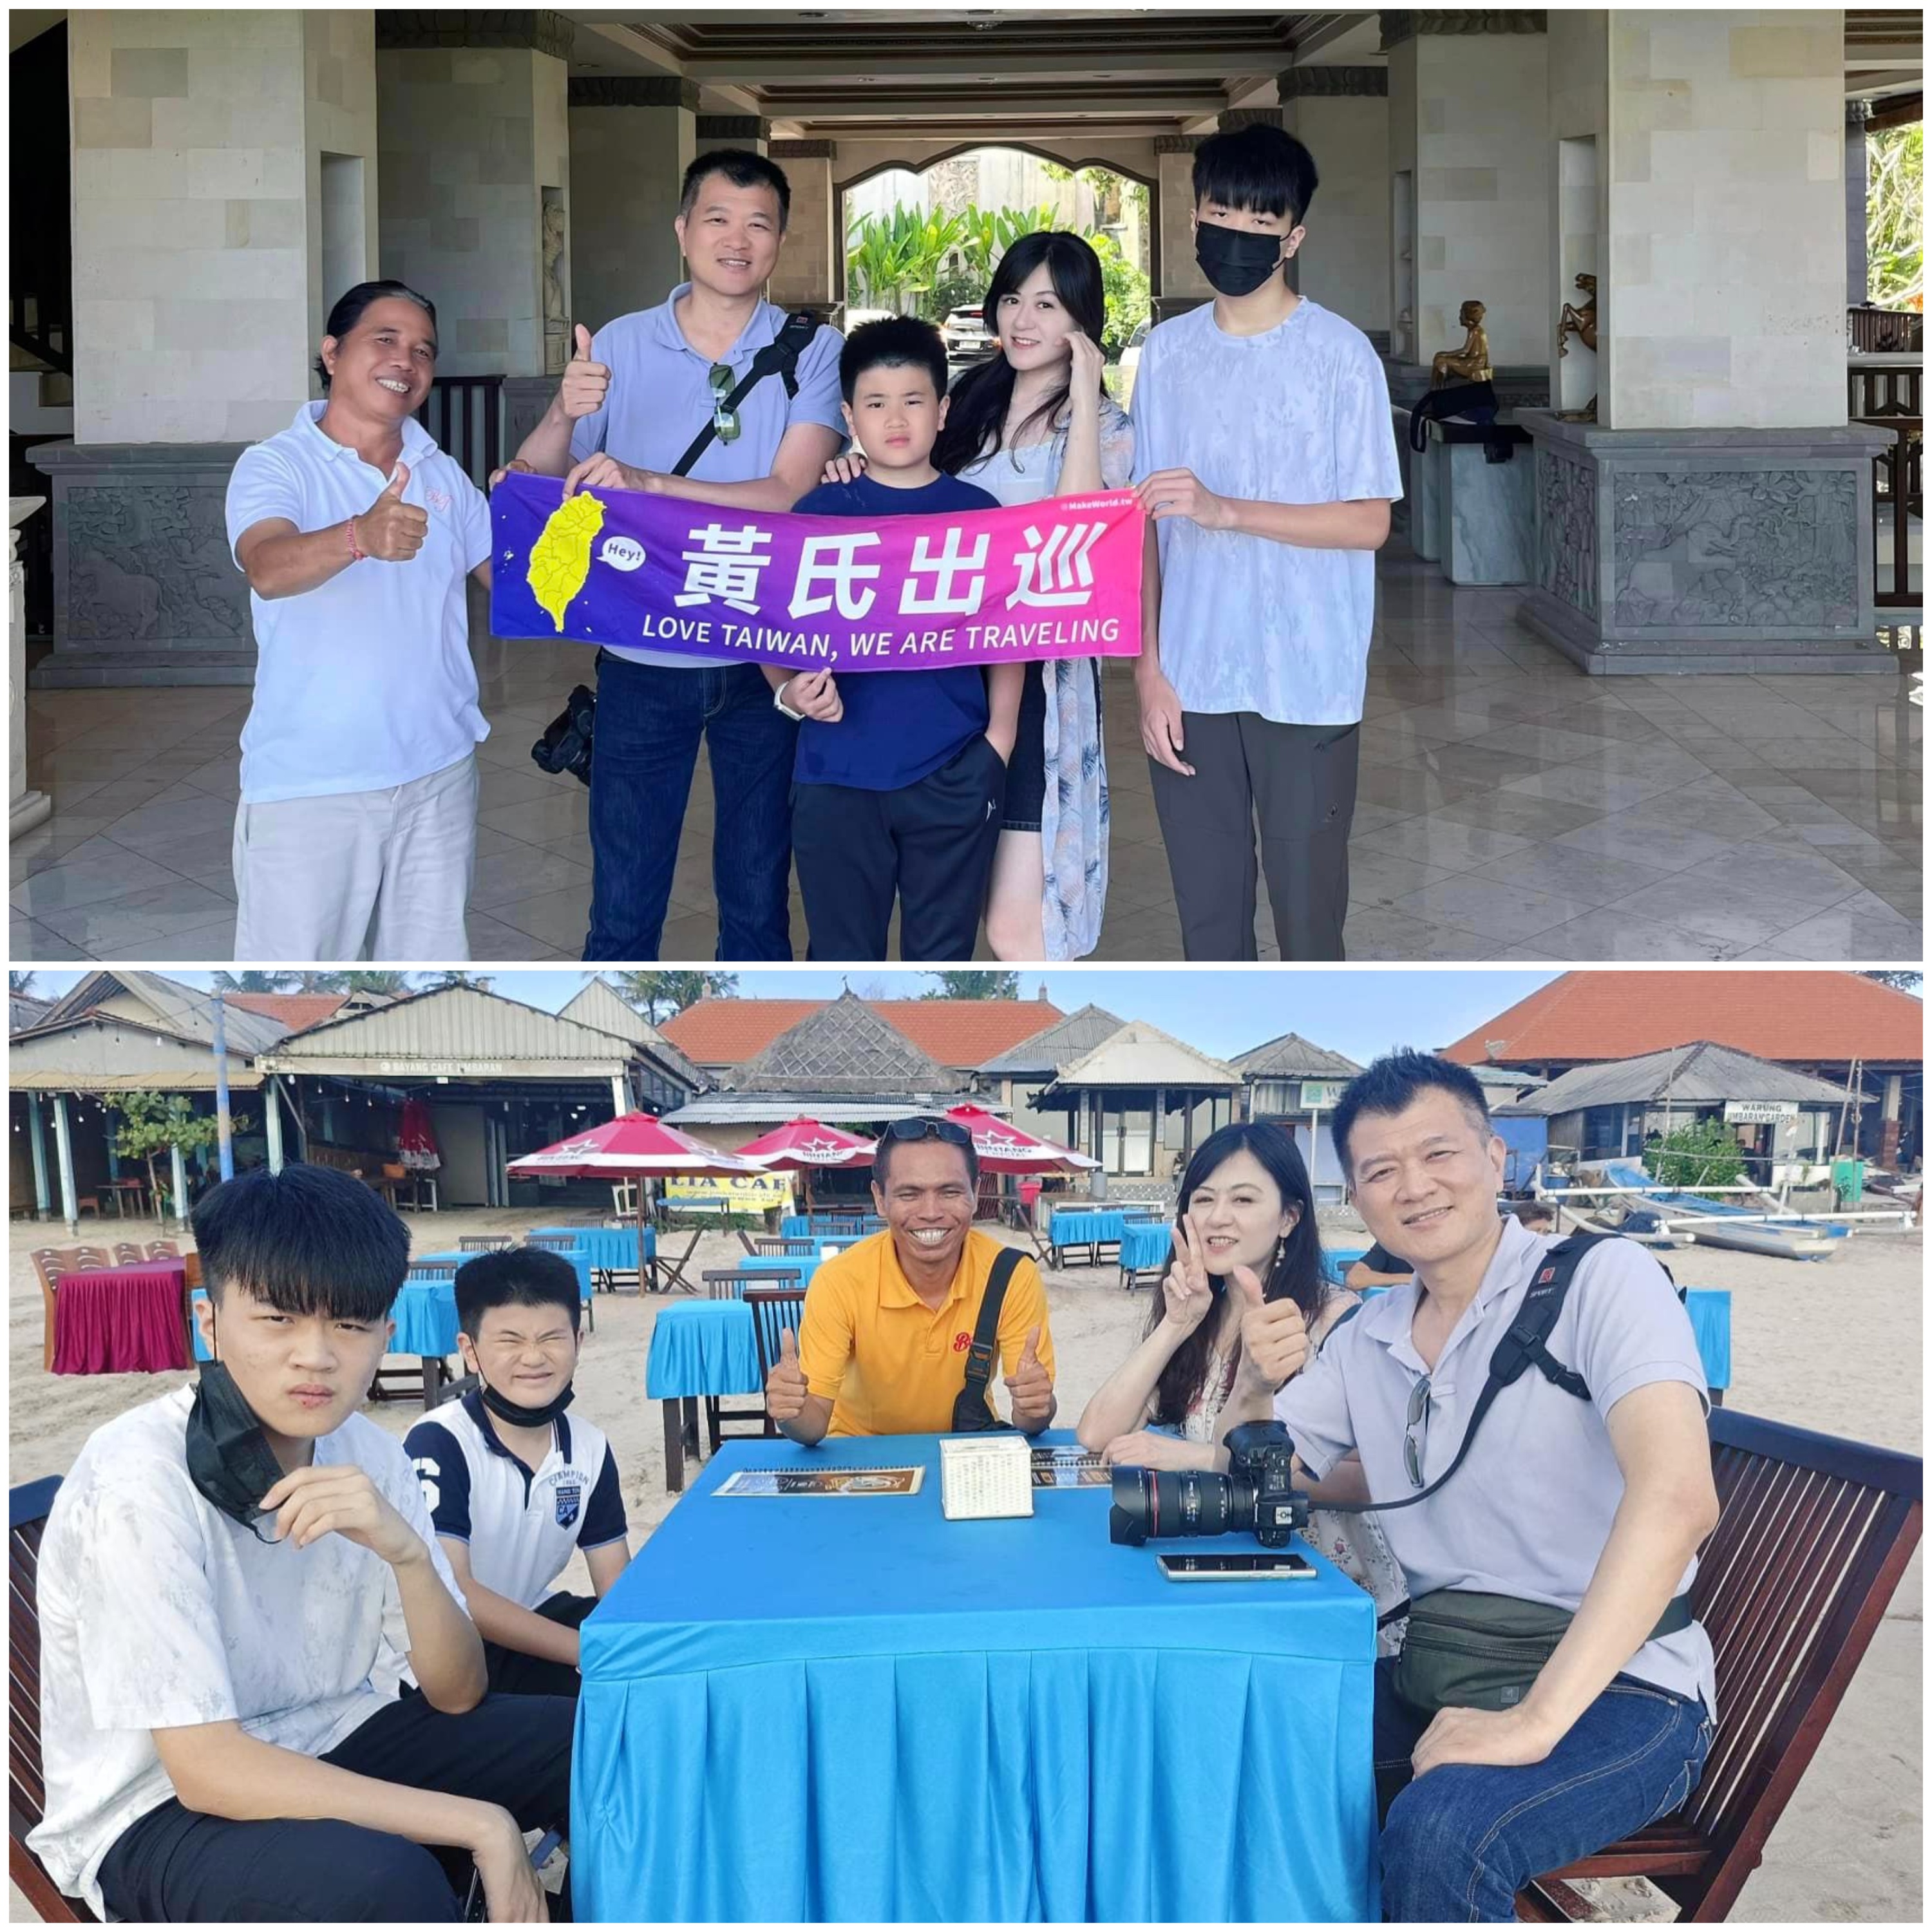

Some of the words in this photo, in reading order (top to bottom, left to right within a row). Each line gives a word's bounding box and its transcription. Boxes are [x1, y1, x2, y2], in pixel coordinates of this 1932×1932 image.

[607, 542, 641, 562] Hey!
[673, 522, 1108, 621] 黃氏出巡
[643, 614, 712, 643] LOVE
[721, 624, 838, 662] TAIWAN,
[850, 632, 893, 656] WE
[900, 629, 956, 654] ARE
[965, 618, 1120, 649] TRAVELING
